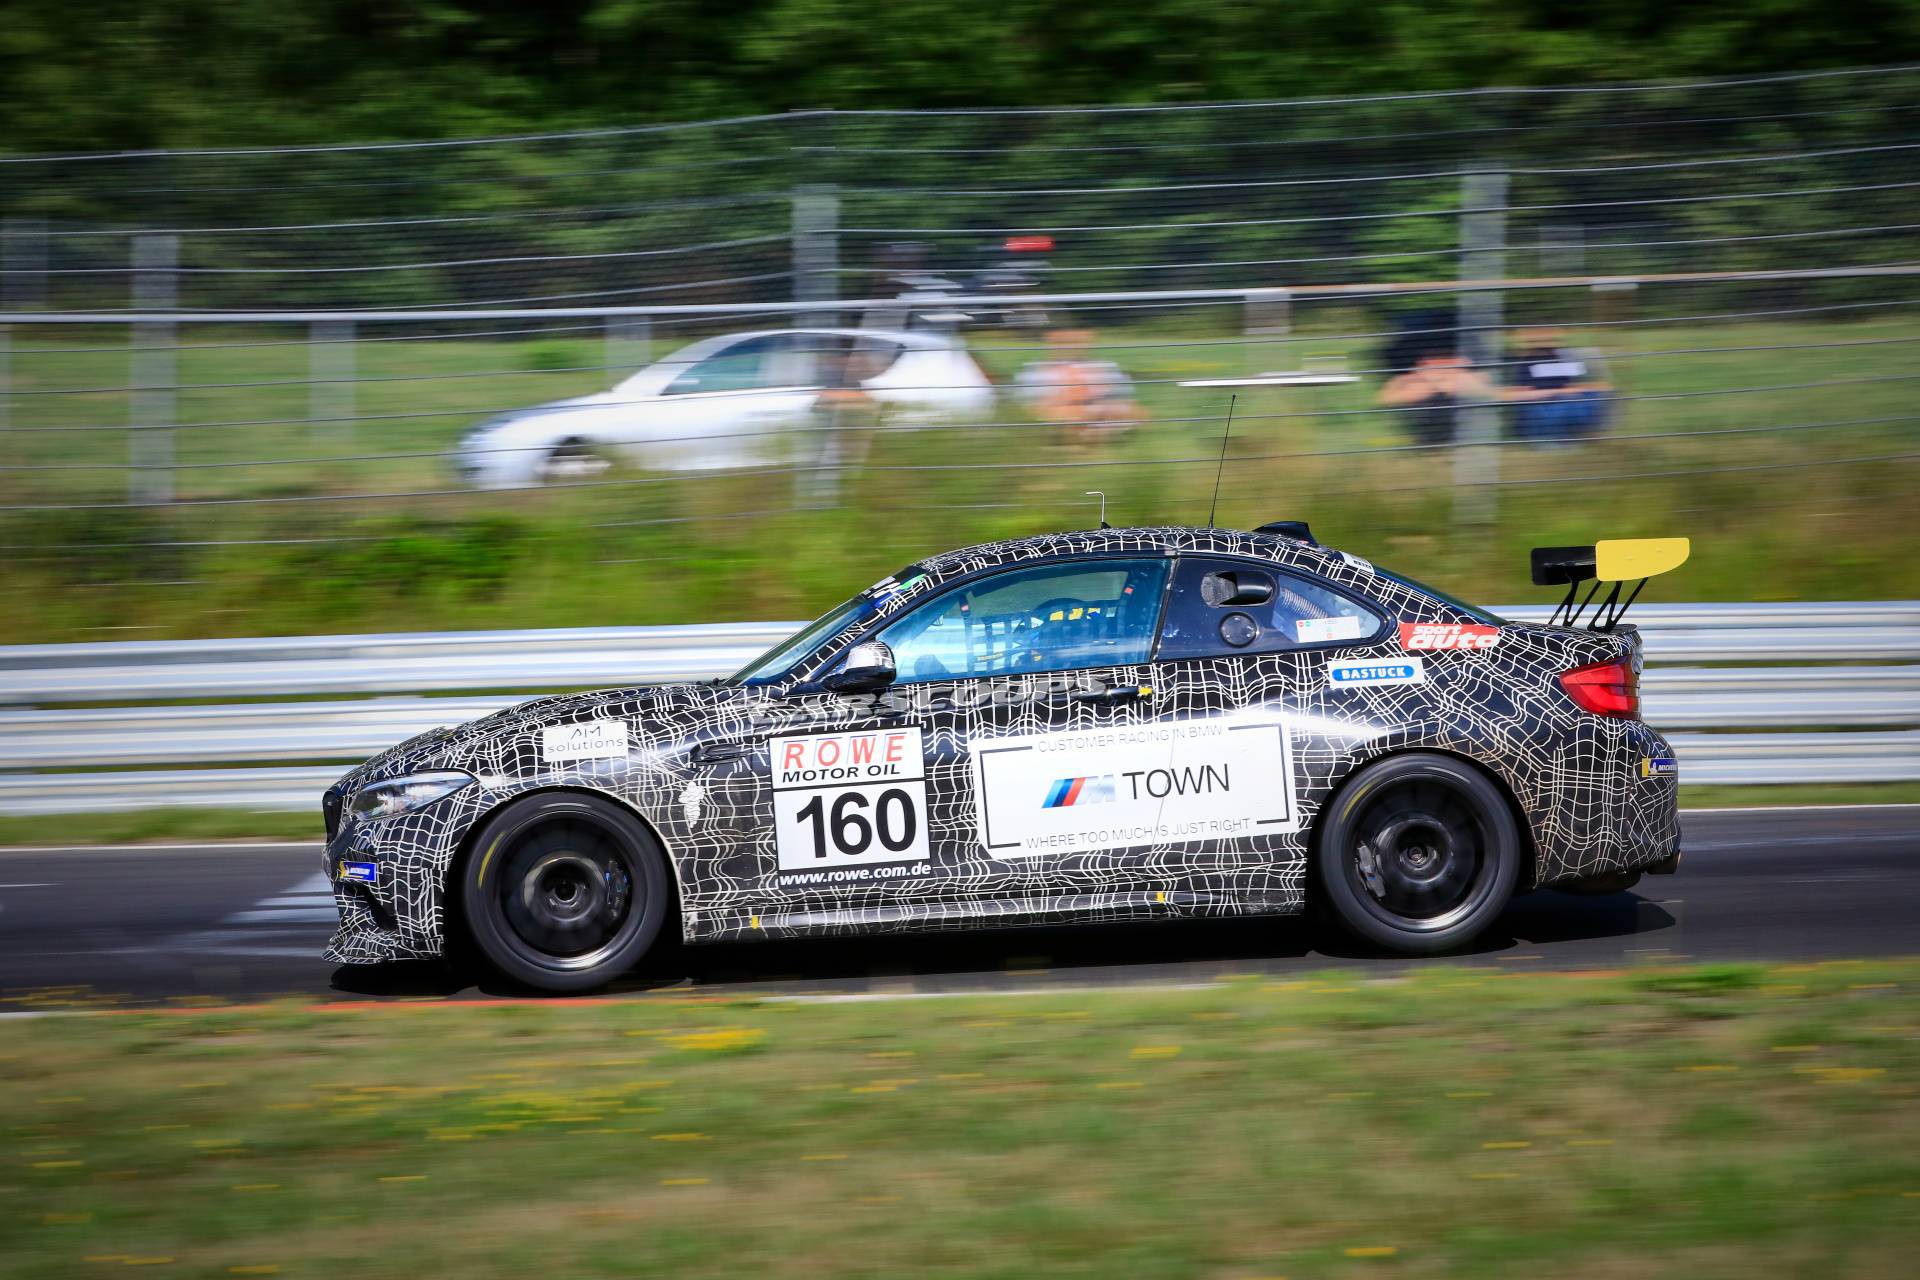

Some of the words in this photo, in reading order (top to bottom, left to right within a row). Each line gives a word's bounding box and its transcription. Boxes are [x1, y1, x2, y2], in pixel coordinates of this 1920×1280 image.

[1408, 631, 1500, 649] auto
[1413, 625, 1463, 636] sport
[1341, 666, 1406, 680] BASTUCK
[547, 738, 624, 754] solutions
[1038, 734, 1116, 752] CUSTOMER
[1119, 729, 1170, 745] RACING
[1172, 727, 1186, 739] IN
[1189, 724, 1223, 738] BMW
[782, 733, 907, 769] ROWE
[782, 766, 859, 783] MOTOR
[867, 764, 901, 776] OIL
[1122, 763, 1230, 799] TOWN
[796, 788, 917, 859] 160
[1026, 833, 1075, 849] WHERE
[1079, 830, 1109, 844] TOO
[1112, 827, 1153, 841] MUCH
[1155, 826, 1169, 838] IS
[1174, 822, 1207, 836] JUST
[1210, 817, 1251, 833] RIGHT
[779, 861, 932, 886] www.rowe.com.de
